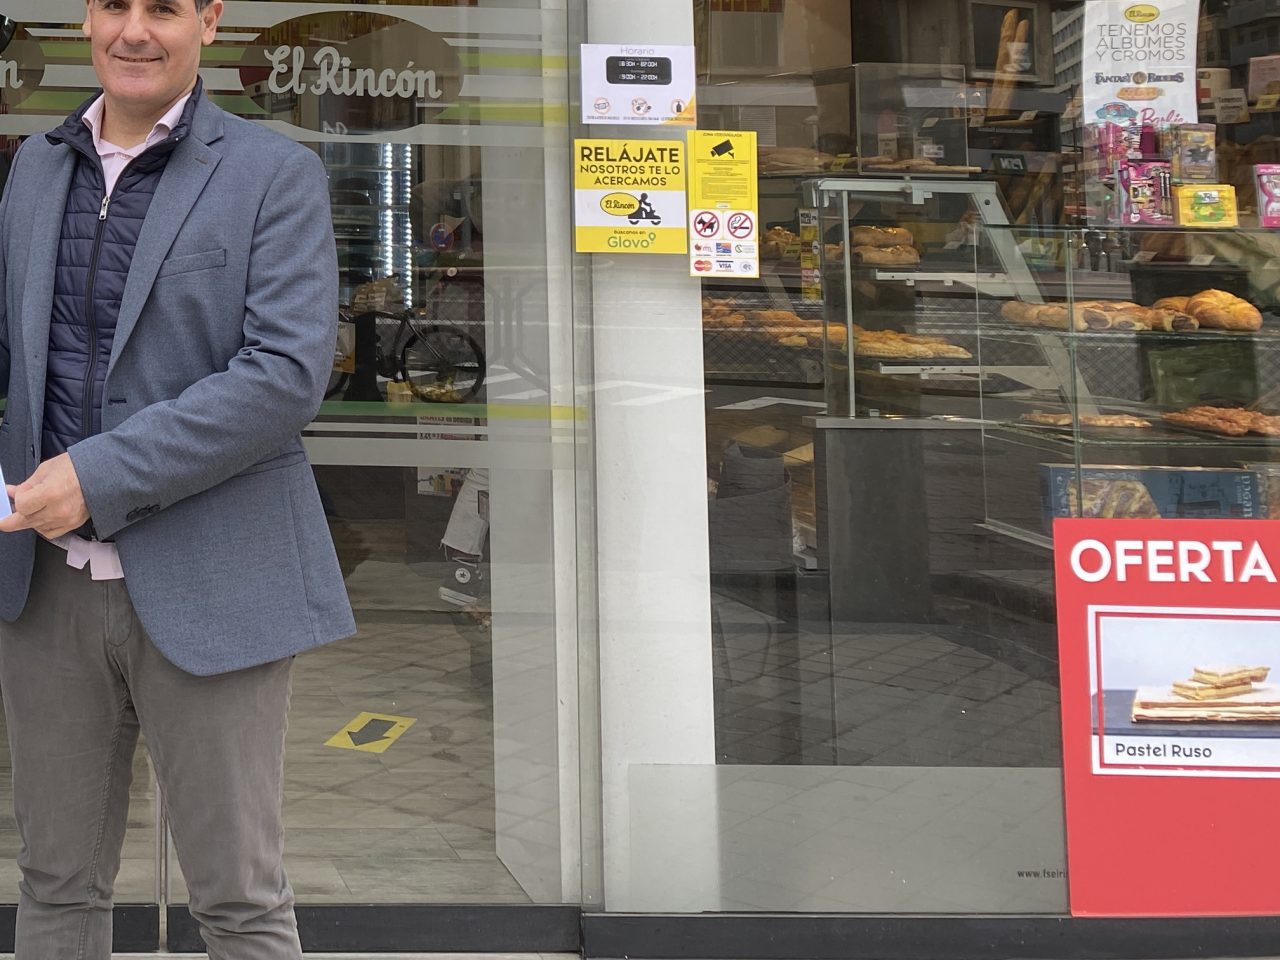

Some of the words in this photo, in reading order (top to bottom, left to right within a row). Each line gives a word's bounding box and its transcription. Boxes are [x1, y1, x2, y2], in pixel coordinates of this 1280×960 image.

[1097, 22, 1187, 37] TENEMOS
[620, 47, 655, 56] Horario
[1096, 50, 1106, 62] Y
[1111, 49, 1186, 62] CROMOS
[264, 46, 309, 98] El
[312, 46, 443, 100] Rincón
[581, 144, 680, 163] RELÁJATE
[581, 164, 646, 175] NOSOTROS
[649, 166, 662, 175] TE
[664, 166, 681, 175] LO
[594, 175, 667, 186] ACERCAMOS
[605, 200, 612, 209] El
[612, 200, 635, 209] Rincón
[607, 236, 650, 248] Glovo
[1070, 540, 1277, 583] OFERTA
[1115, 743, 1167, 757] Pastel
[1172, 744, 1212, 758] Ruso
